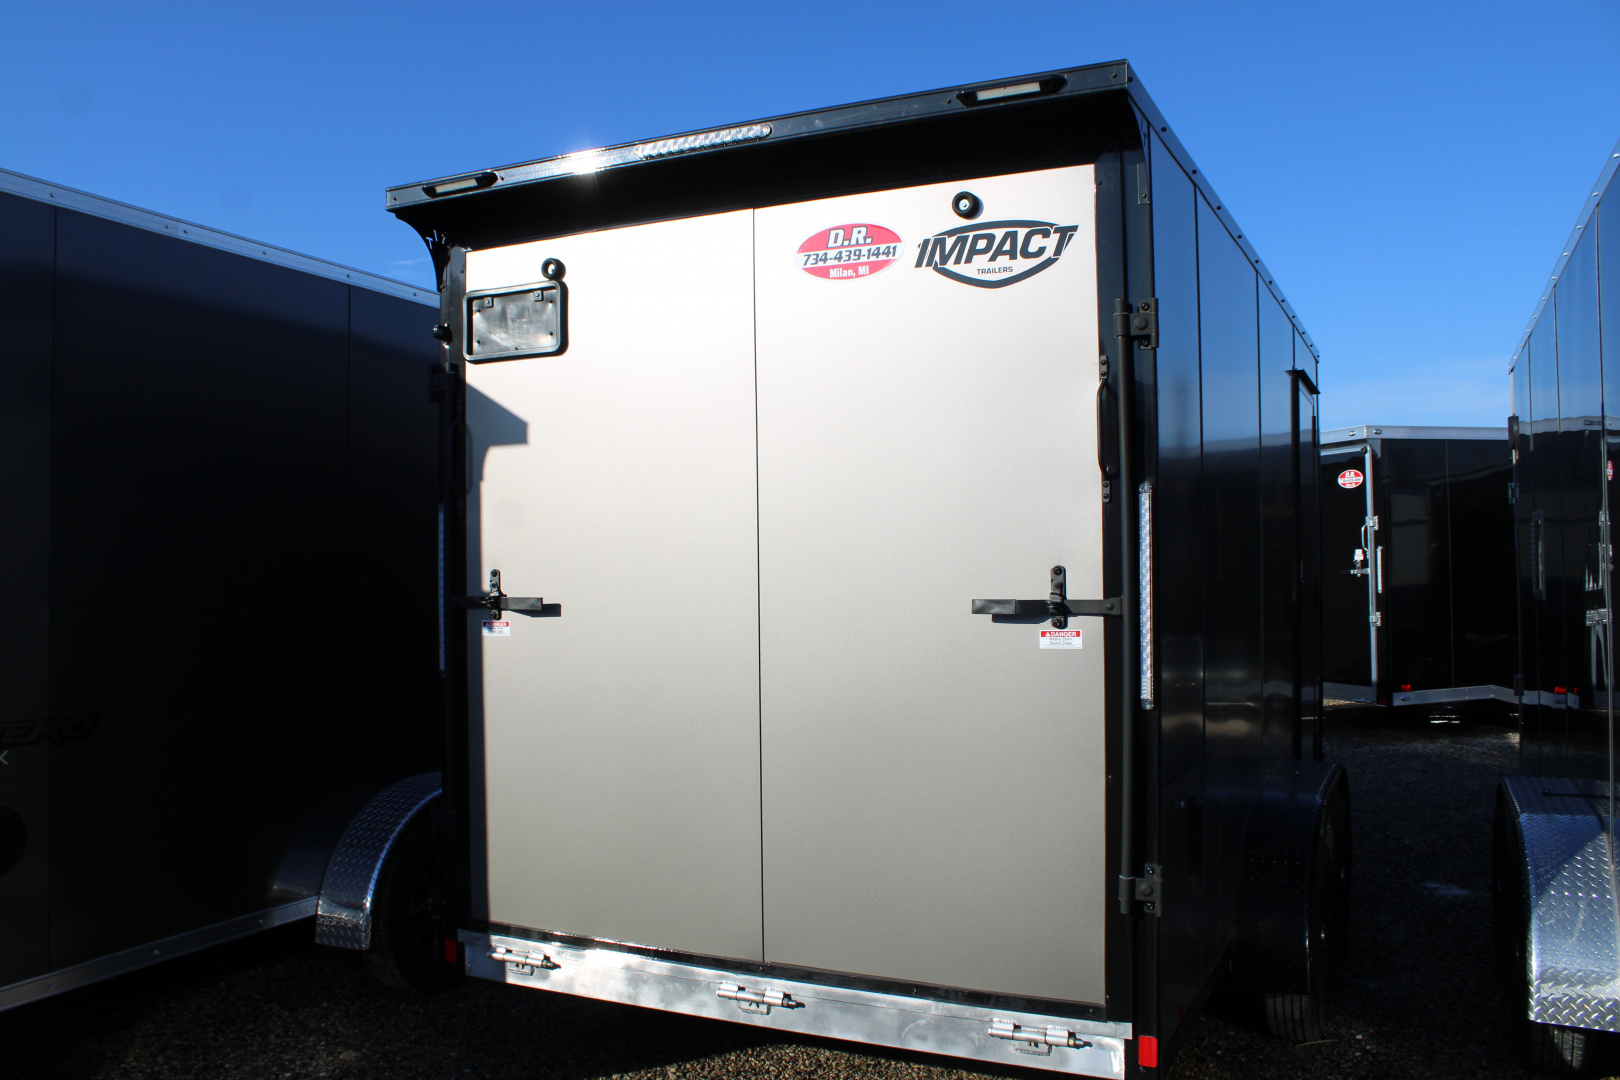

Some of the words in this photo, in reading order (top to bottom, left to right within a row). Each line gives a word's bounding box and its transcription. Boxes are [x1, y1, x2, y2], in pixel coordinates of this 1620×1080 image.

[826, 225, 873, 248] D.R.
[914, 225, 1079, 268] IMPACT
[803, 245, 897, 266] 734-439-1441
[829, 267, 856, 278] Milan,
[858, 265, 869, 275] MI
[977, 266, 1013, 275] TRAILERS
